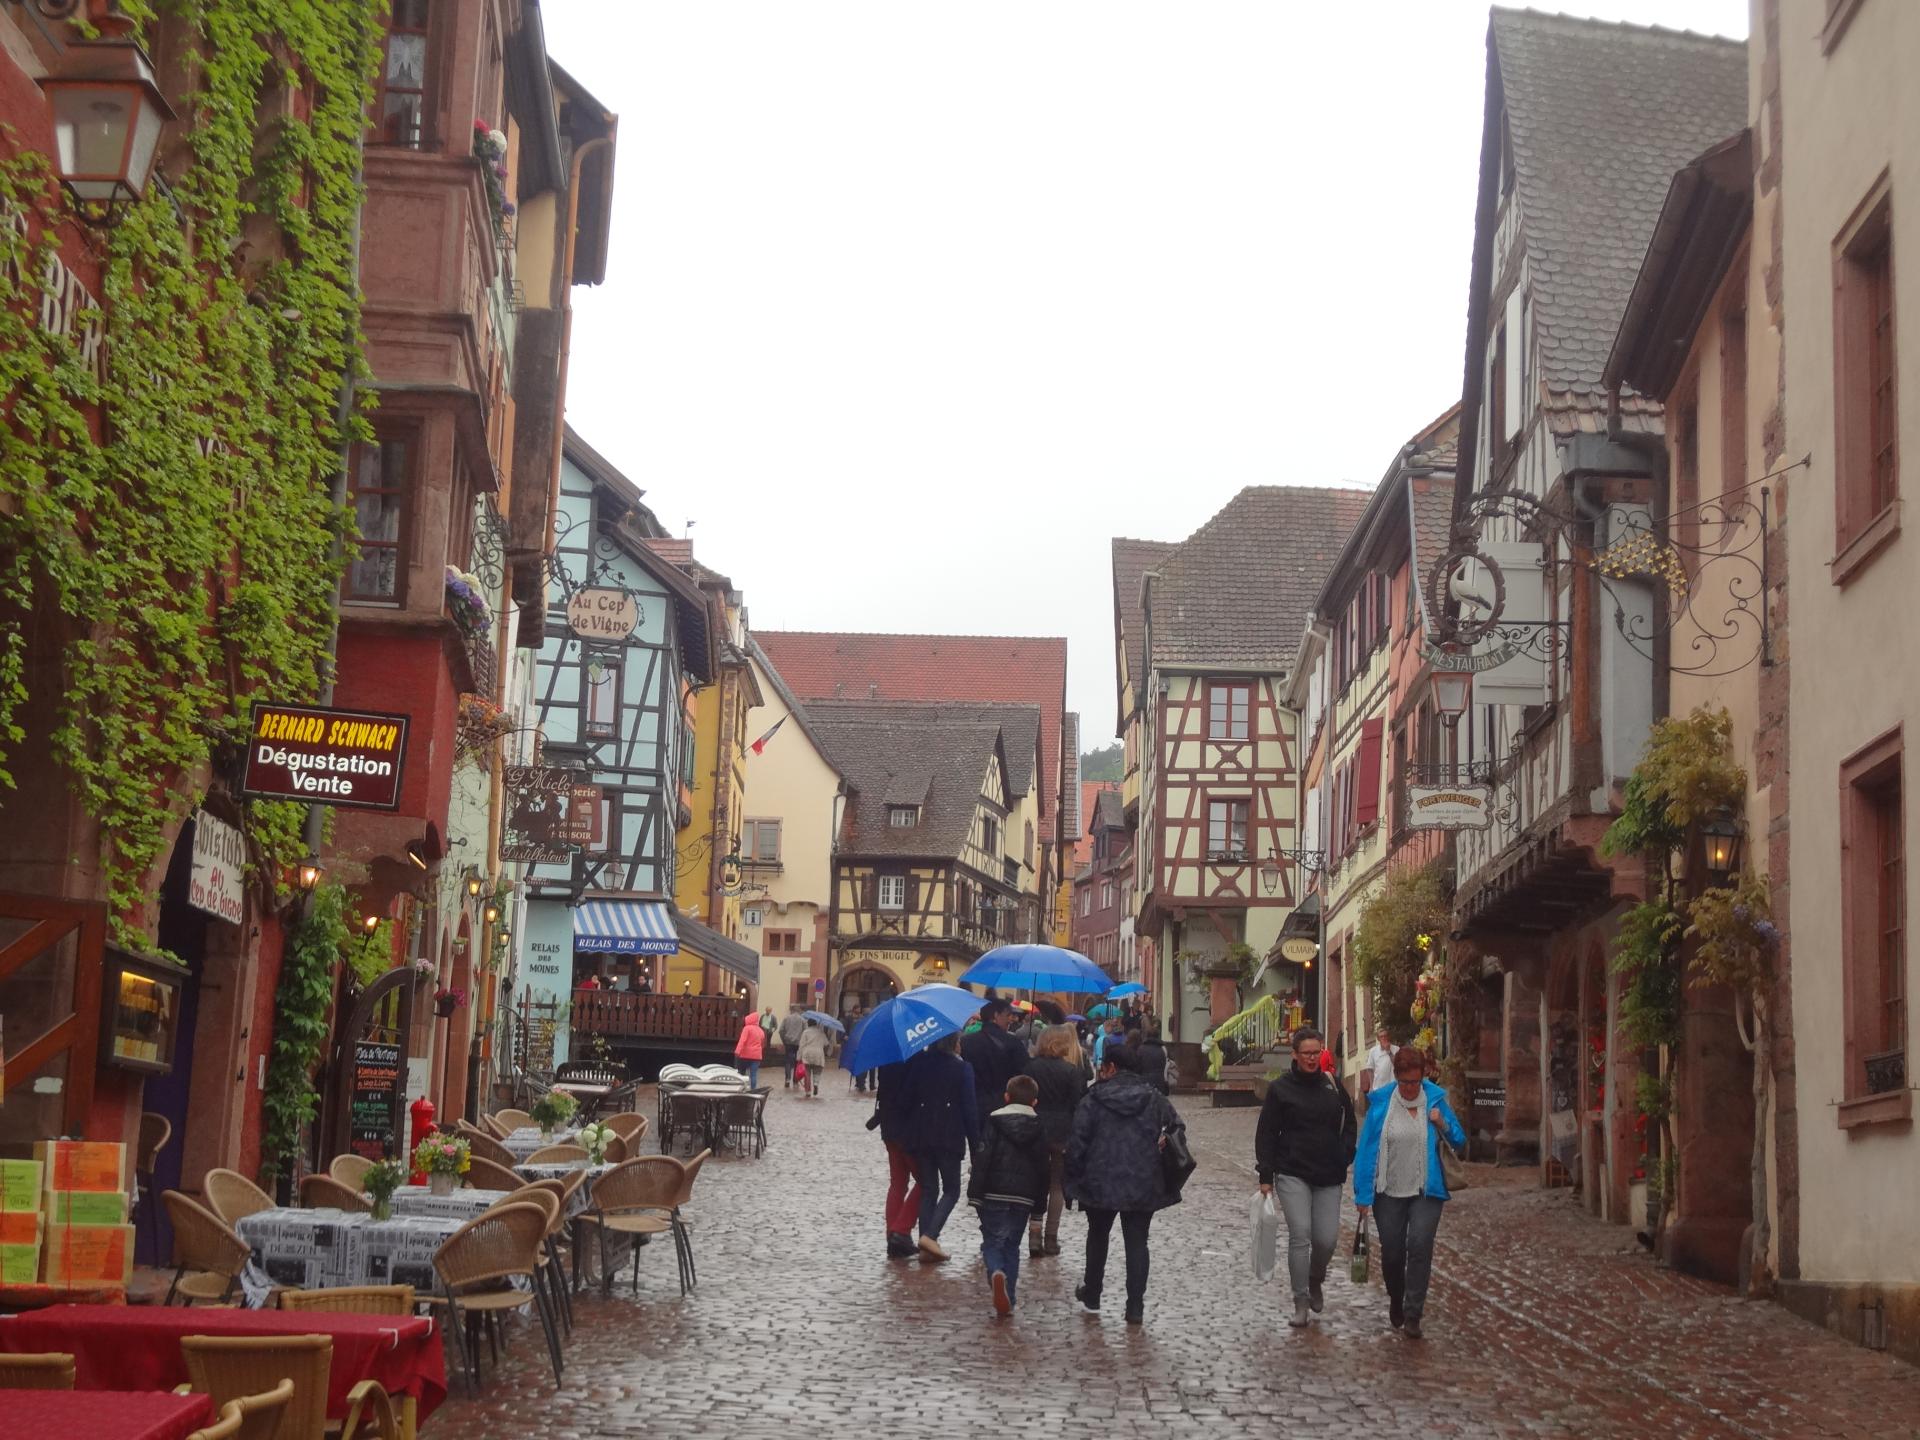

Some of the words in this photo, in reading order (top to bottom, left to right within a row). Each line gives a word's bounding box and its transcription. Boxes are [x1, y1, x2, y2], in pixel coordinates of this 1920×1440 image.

[572, 594, 591, 609] Au
[598, 596, 624, 615] Cep
[572, 614, 588, 629] de
[591, 615, 629, 634] Vigne
[1430, 648, 1505, 671] RESTAURANT
[259, 713, 325, 744] BERNARD
[328, 720, 397, 751] SCHWACH
[257, 744, 391, 776] Dégustation
[292, 771, 353, 795] Vente
[1416, 793, 1481, 809] FORTWENGER
[531, 943, 560, 953] RELAIS
[579, 938, 612, 948] RELAIS
[618, 940, 635, 949] DES
[641, 942, 676, 951] MOINES
[1286, 944, 1315, 954] VILMAIN
[860, 951, 879, 960] FINS
[529, 964, 560, 974] MOINES
[906, 1016, 938, 1042] AGC
